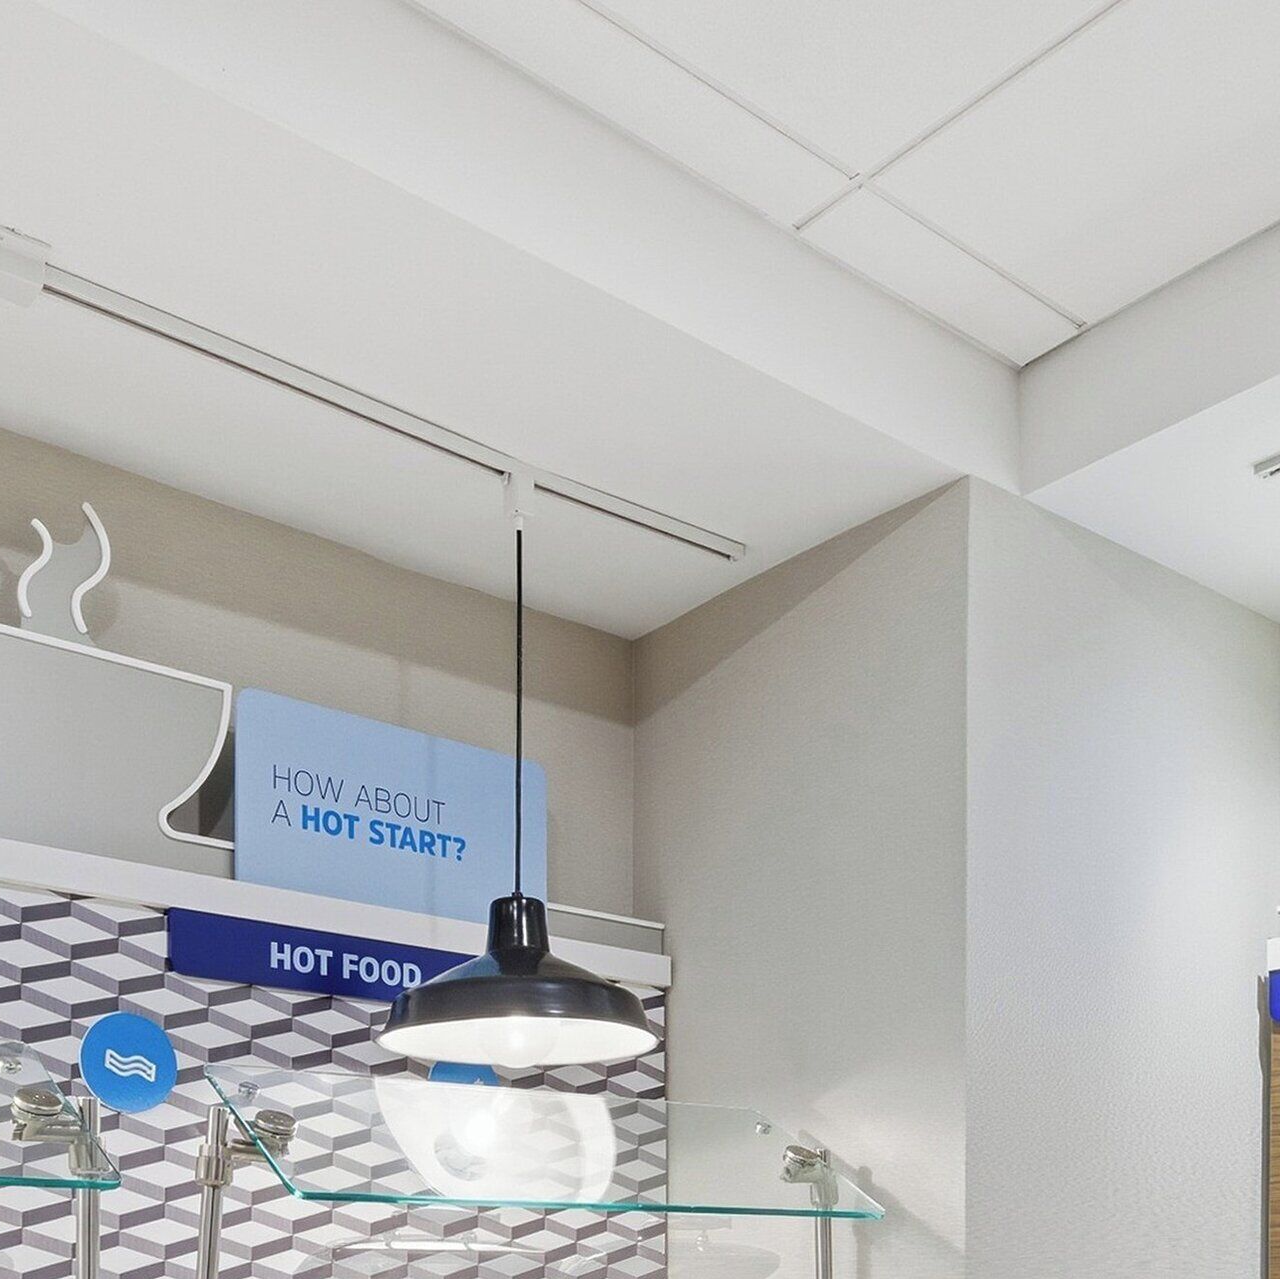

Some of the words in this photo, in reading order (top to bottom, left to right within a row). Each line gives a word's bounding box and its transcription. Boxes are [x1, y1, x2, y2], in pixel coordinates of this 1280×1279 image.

[272, 763, 345, 803] HOW
[354, 785, 446, 826] ABOUT
[271, 799, 292, 827] A
[301, 804, 360, 838] HOT
[368, 818, 467, 862] START?
[270, 941, 333, 976] HOT
[341, 954, 422, 989] FOOD
